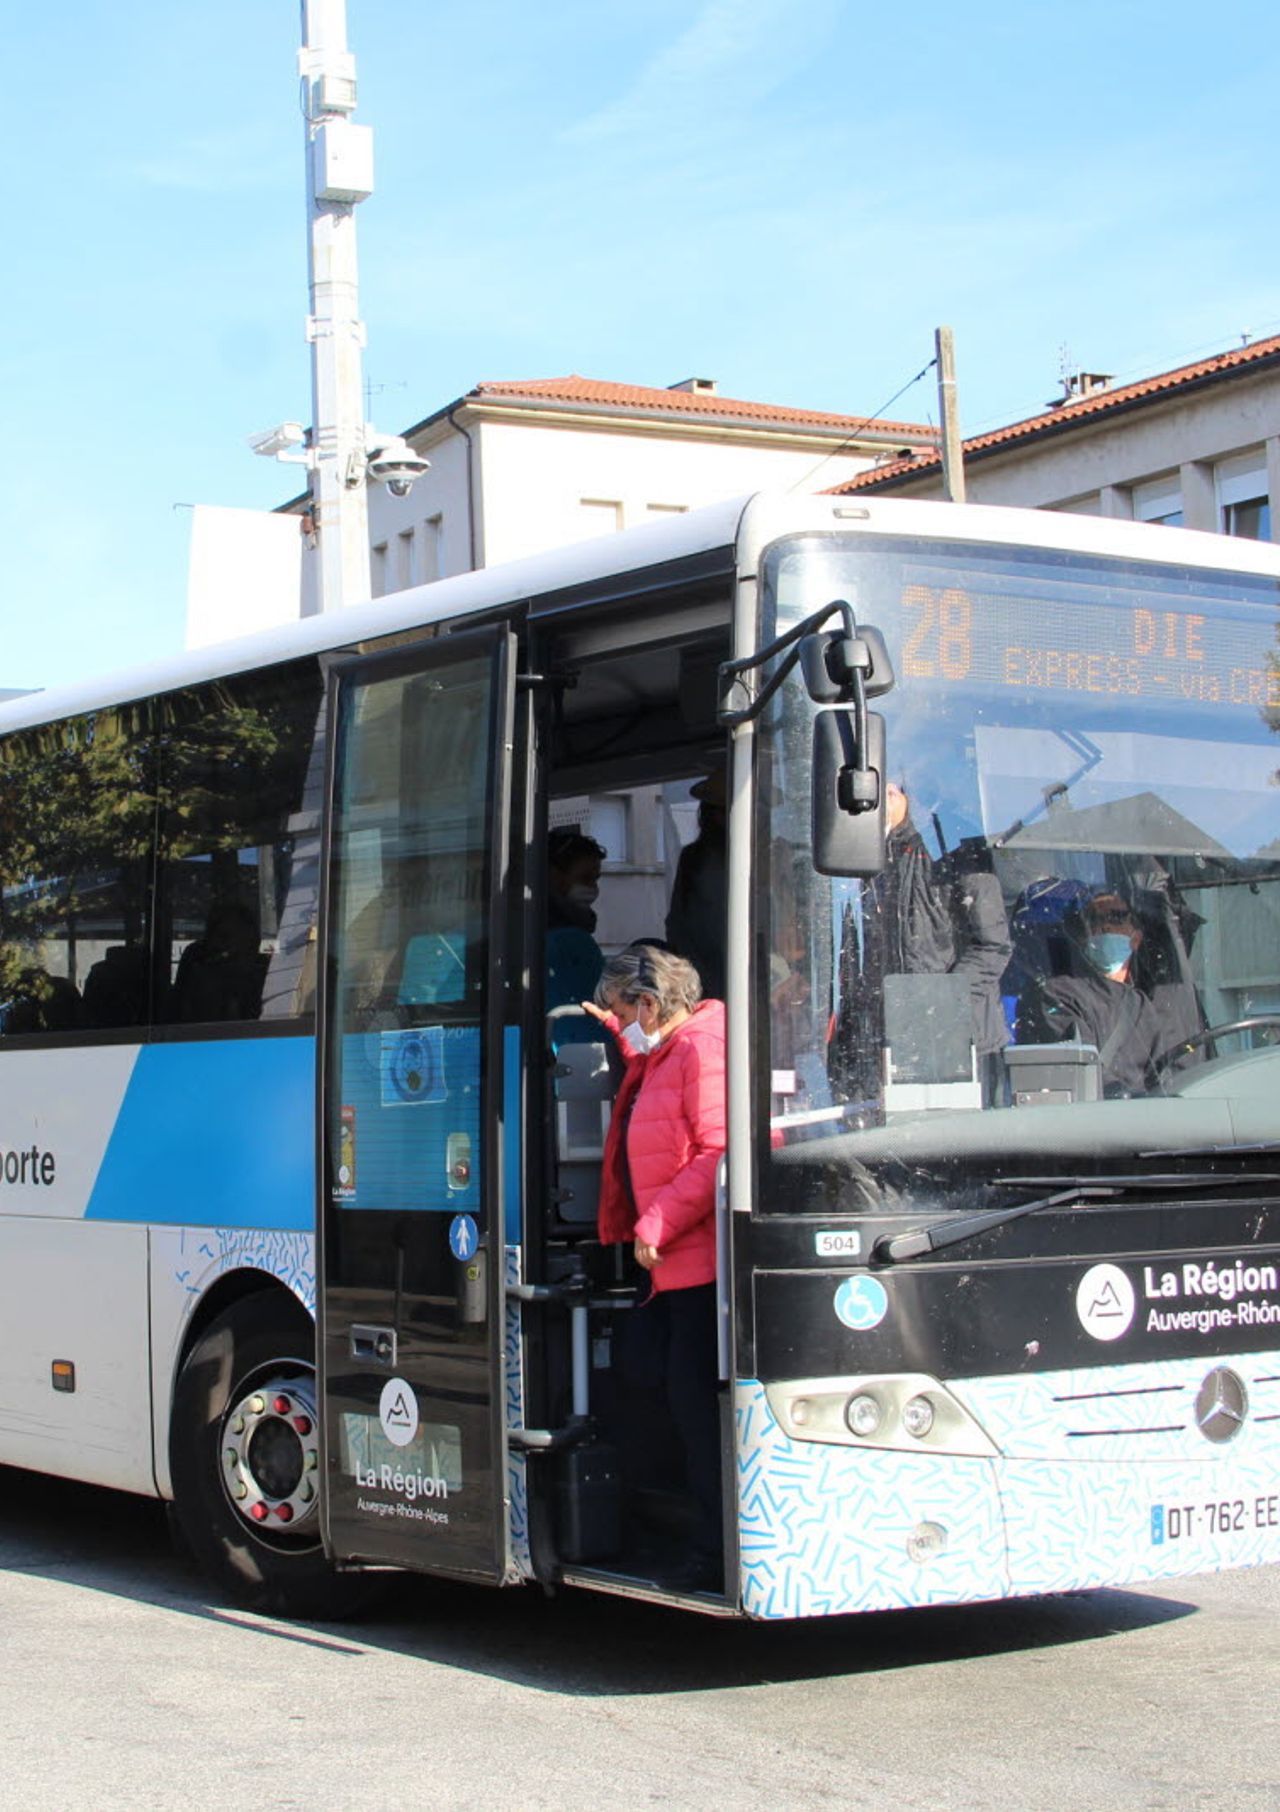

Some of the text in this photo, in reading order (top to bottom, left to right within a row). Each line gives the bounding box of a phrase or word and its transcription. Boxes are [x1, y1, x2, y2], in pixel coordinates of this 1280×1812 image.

[902, 584, 973, 680] 28
[1132, 608, 1206, 660] DIE
[1004, 646, 1143, 695] EXPRESS
[0, 1144, 56, 1186] orte
[822, 1236, 855, 1251] 504
[1144, 1260, 1277, 1300] La Région
[355, 1460, 448, 1500] La Région
[357, 1497, 449, 1524] Auvergne-Rhône-Alpes
